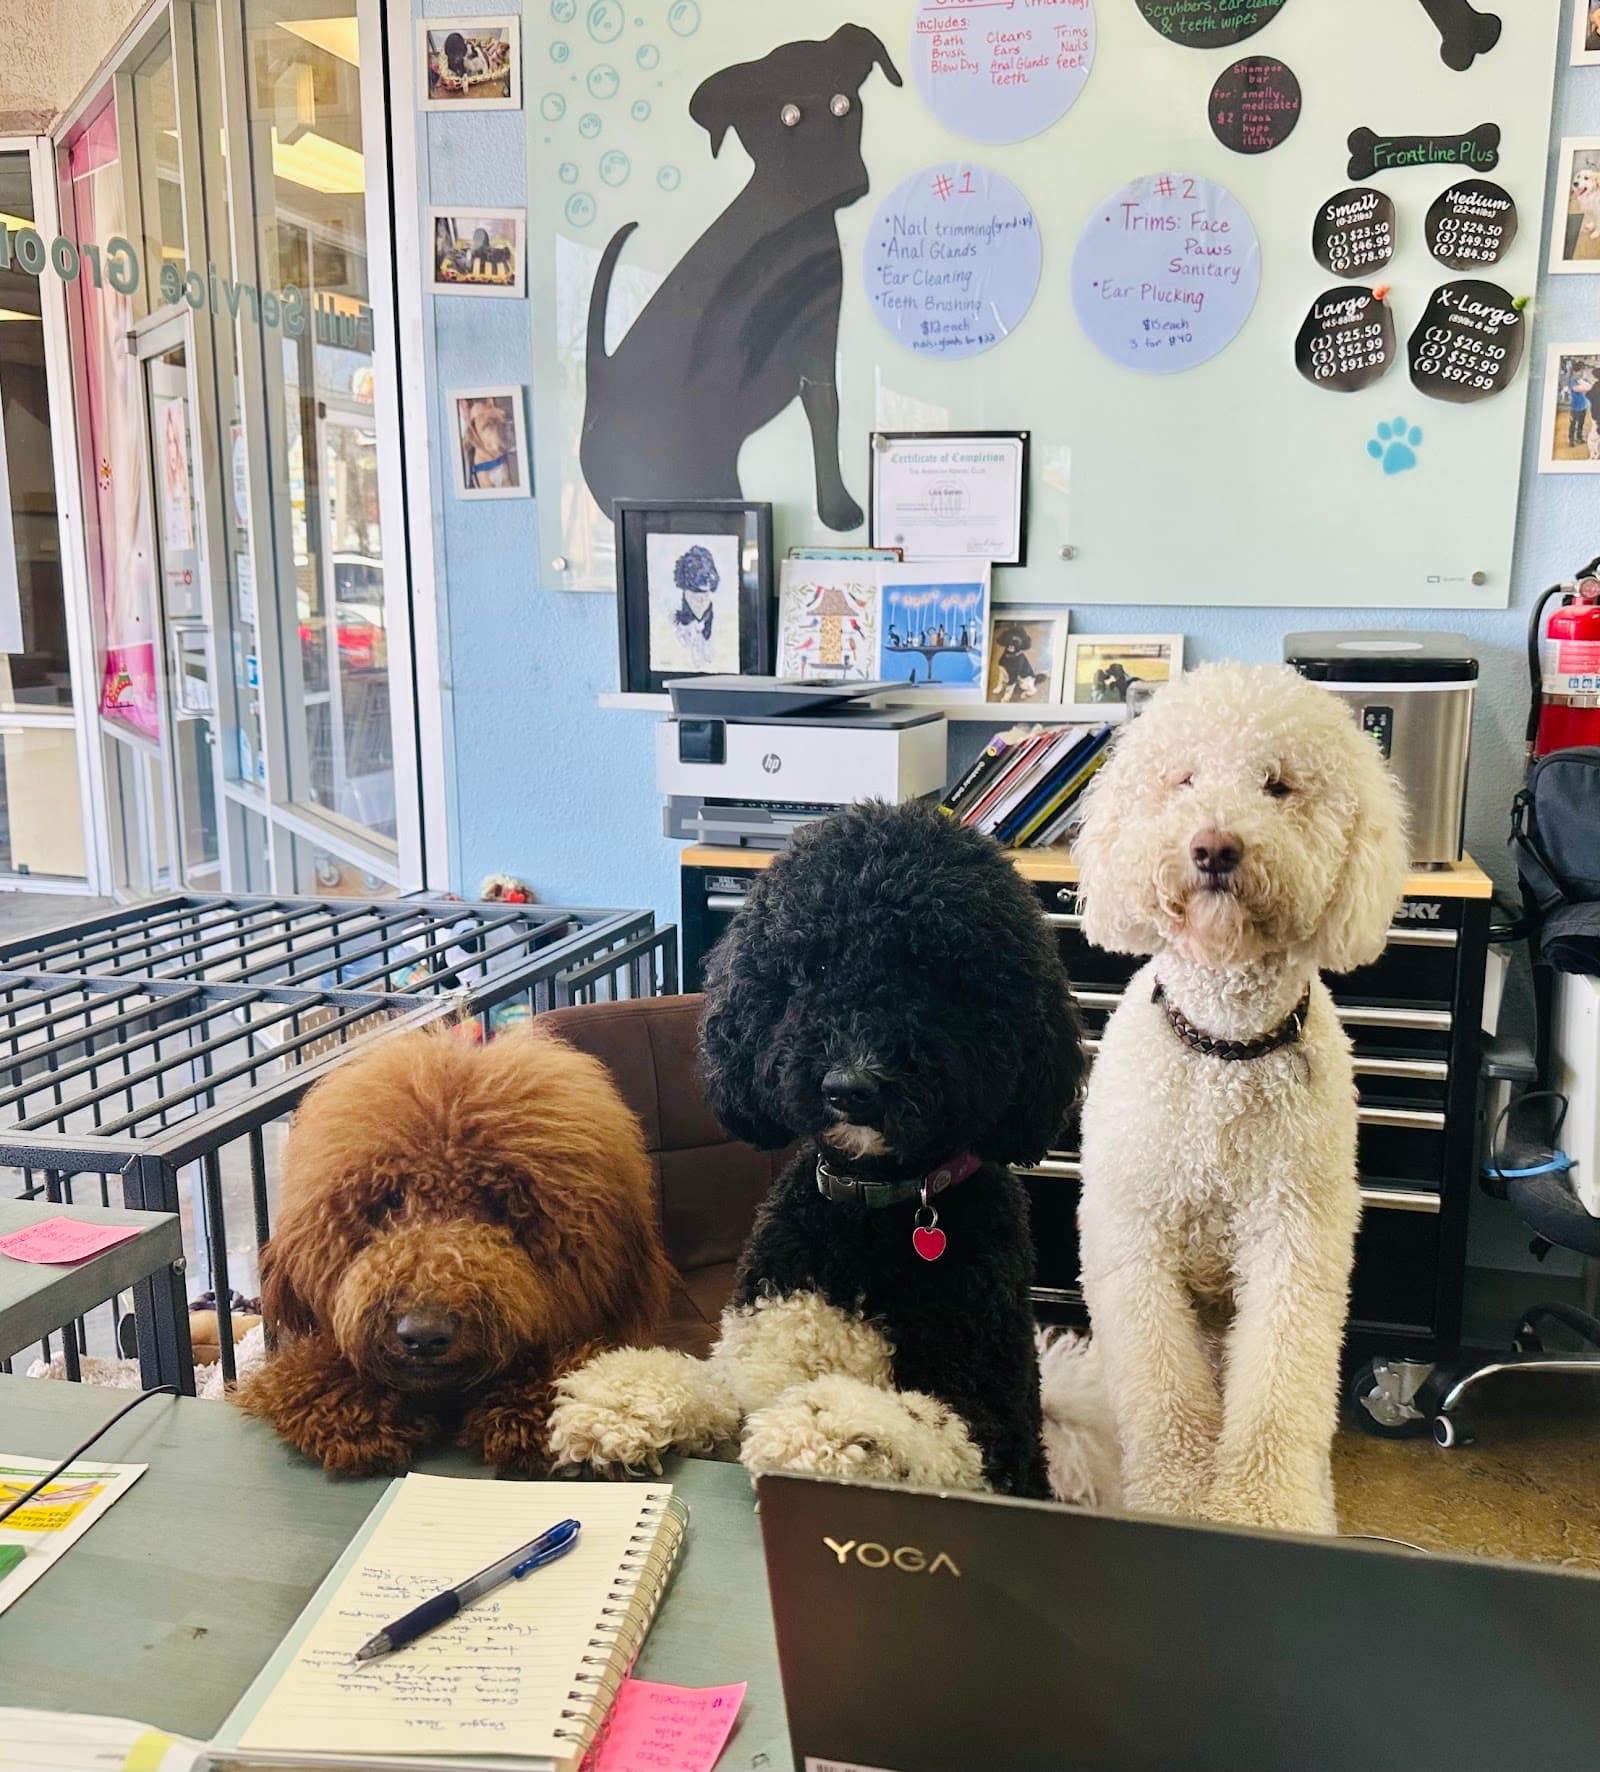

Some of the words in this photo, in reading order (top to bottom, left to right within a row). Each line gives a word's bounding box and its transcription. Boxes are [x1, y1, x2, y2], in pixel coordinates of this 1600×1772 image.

[1054, 24, 1089, 38] Trims
[1161, 17, 1173, 33] &
[1180, 15, 1217, 32] teeth
[1221, 13, 1258, 29] wipes
[932, 35, 965, 47] Bath
[986, 30, 1033, 44] Cleans
[1061, 41, 1089, 53] Nails
[932, 47, 966, 59] Brush
[993, 45, 1021, 57] Ears
[931, 60, 959, 73] Blow
[960, 60, 979, 74] Dry
[990, 58, 1014, 71] Anal
[990, 70, 1030, 86] Teeth
[1248, 74, 1270, 83] bar
[1242, 97, 1299, 110] medicated
[1243, 134, 1274, 148] itchy
[1373, 141, 1457, 168] Frontline
[1459, 141, 1495, 163] Plus
[1326, 193, 1379, 221] Small
[1445, 190, 1511, 211] Medium
[892, 215, 928, 237] Nail
[1120, 202, 1182, 231] Trims:
[1190, 209, 1232, 233] Face
[1438, 217, 1460, 231] (1)
[1461, 221, 1503, 236] $24.50
[1327, 232, 1347, 248] (1)
[1349, 222, 1389, 242] $23.50
[1436, 230, 1457, 244] (3)
[1458, 234, 1500, 249] $49.99
[887, 236, 925, 259] Anal
[929, 241, 977, 260] Glands
[1184, 237, 1233, 256] Paws
[1329, 244, 1349, 260] (3)
[1351, 234, 1391, 254] $46.99
[1433, 243, 1454, 256] (6)
[1455, 246, 1497, 261] $84.99
[1330, 256, 1351, 272] (6)
[1353, 246, 1393, 266] $78.99
[882, 265, 911, 286] Ear
[912, 268, 973, 292] Cleaning
[1168, 257, 1242, 285] Sanitary
[881, 290, 919, 310] Teeth
[1101, 278, 1135, 300] Ear
[1141, 282, 1205, 313] Plucking
[1314, 296, 1371, 320] Large
[1436, 288, 1519, 327] X-Large
[1310, 337, 1332, 353] (1)
[1335, 323, 1382, 346] $25.50
[1425, 325, 1452, 344] (1)
[1453, 334, 1506, 360] $26.50
[1312, 349, 1334, 367] (3)
[1337, 337, 1384, 359] $52.99
[1419, 341, 1446, 359] (3)
[1447, 350, 1500, 375] $55.99
[1314, 362, 1337, 380] (6)
[1339, 351, 1386, 374] $91.99
[1413, 357, 1441, 374] (6)
[1441, 365, 1494, 391] $97.99
[1394, 903, 1441, 919] SKY
[823, 1536, 961, 1578] YOGA
